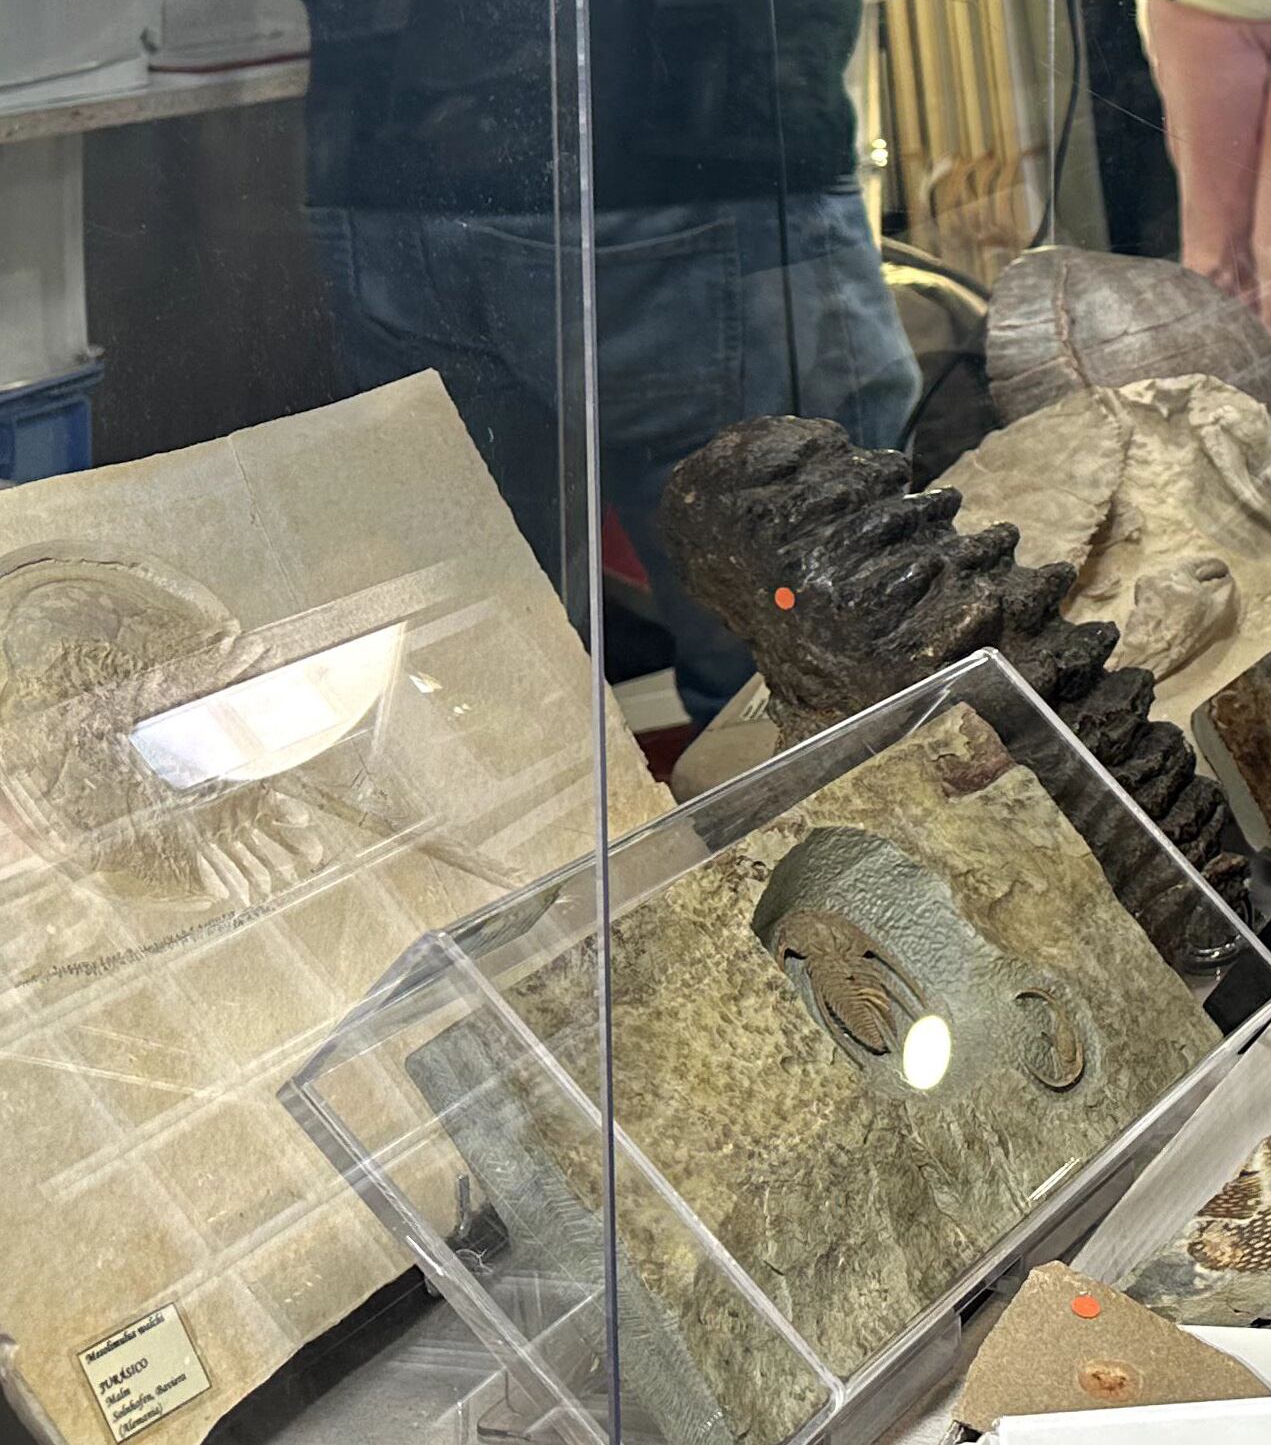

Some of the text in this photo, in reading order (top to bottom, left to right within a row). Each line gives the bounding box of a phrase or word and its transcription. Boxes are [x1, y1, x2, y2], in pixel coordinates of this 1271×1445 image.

[99, 1358, 148, 1394] JURÁSICO
[155, 1373, 187, 1395] Baviera
[106, 1387, 131, 1407] Malm
